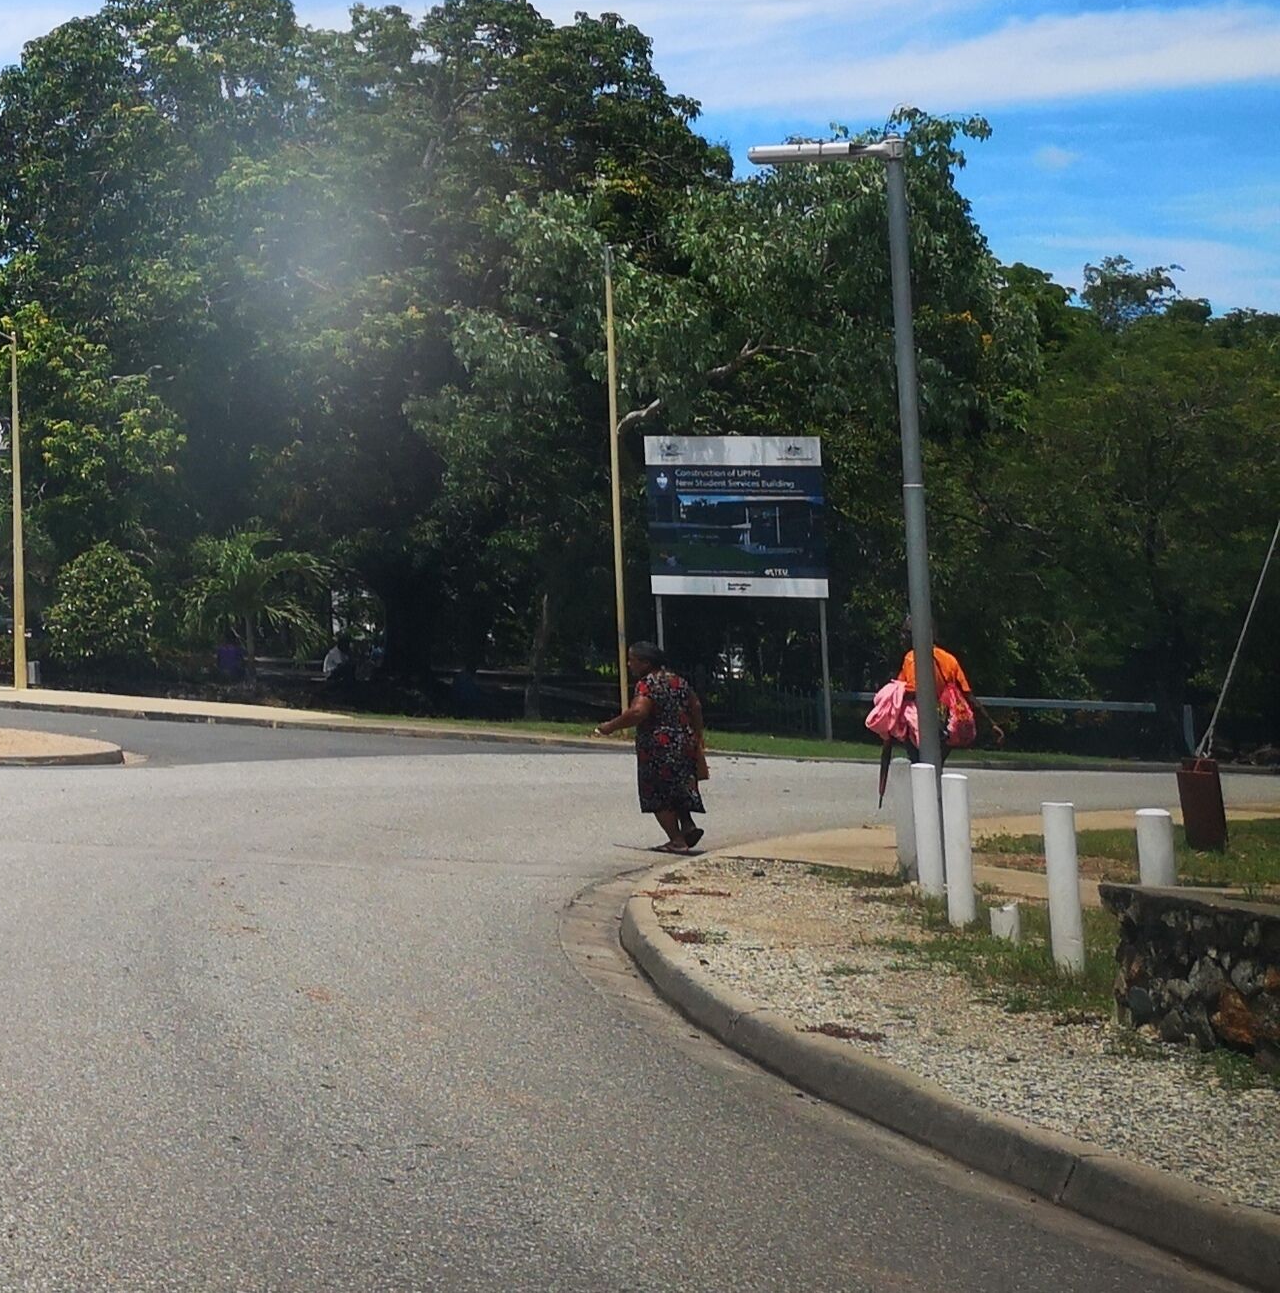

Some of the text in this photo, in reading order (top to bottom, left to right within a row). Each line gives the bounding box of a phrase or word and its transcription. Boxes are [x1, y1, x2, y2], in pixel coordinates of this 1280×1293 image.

[674, 469, 761, 477] Construction of UPNG
[675, 479, 693, 487] New
[695, 479, 726, 487] Student
[761, 480, 795, 489] Building
